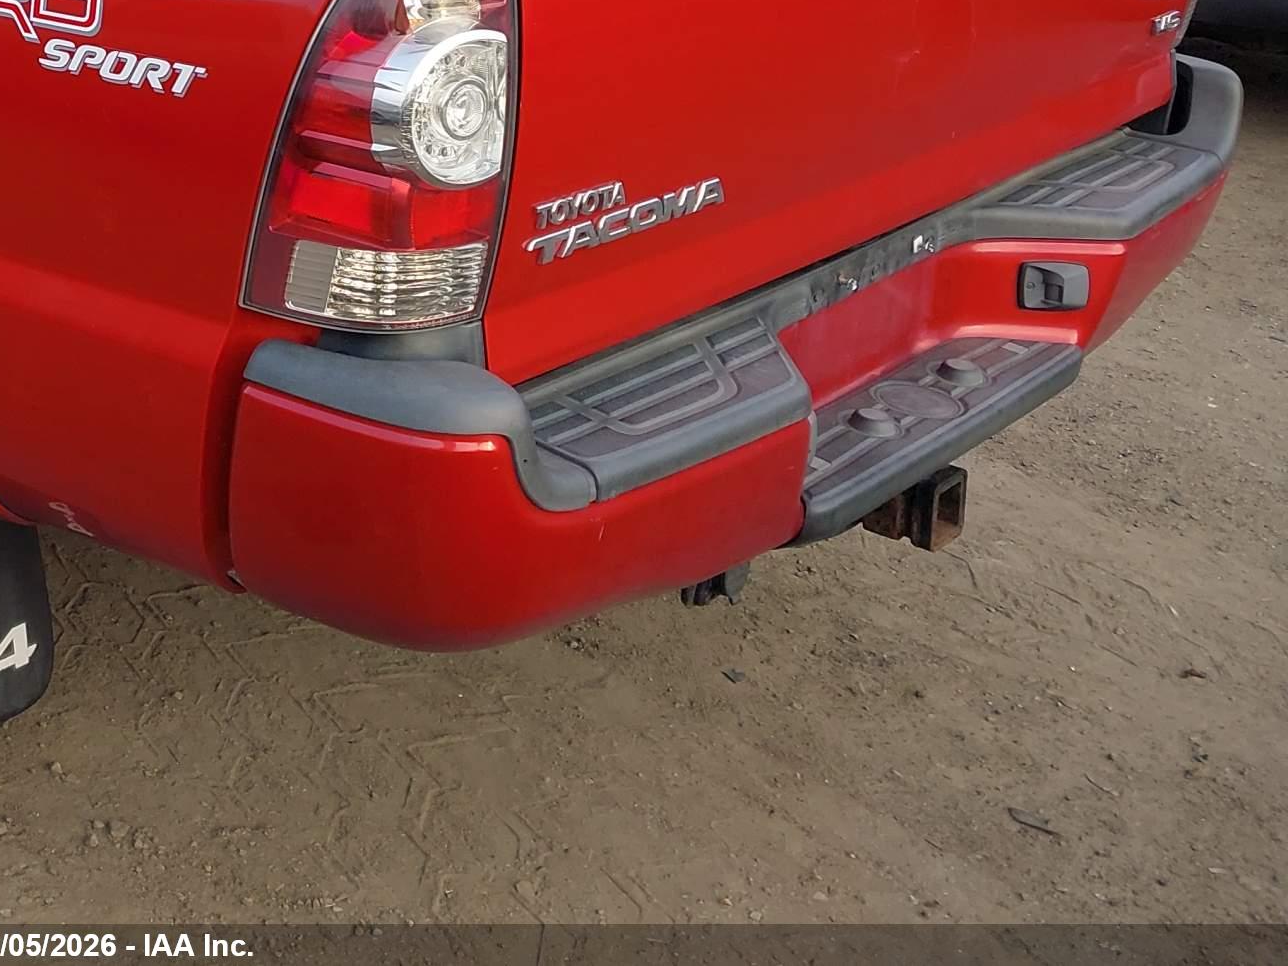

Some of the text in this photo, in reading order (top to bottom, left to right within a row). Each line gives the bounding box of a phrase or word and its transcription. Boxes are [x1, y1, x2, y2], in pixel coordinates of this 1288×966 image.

[38, 38, 208, 98] SPORT
[522, 177, 726, 265] TACOMA
[534, 181, 626, 230] TOYOTA
